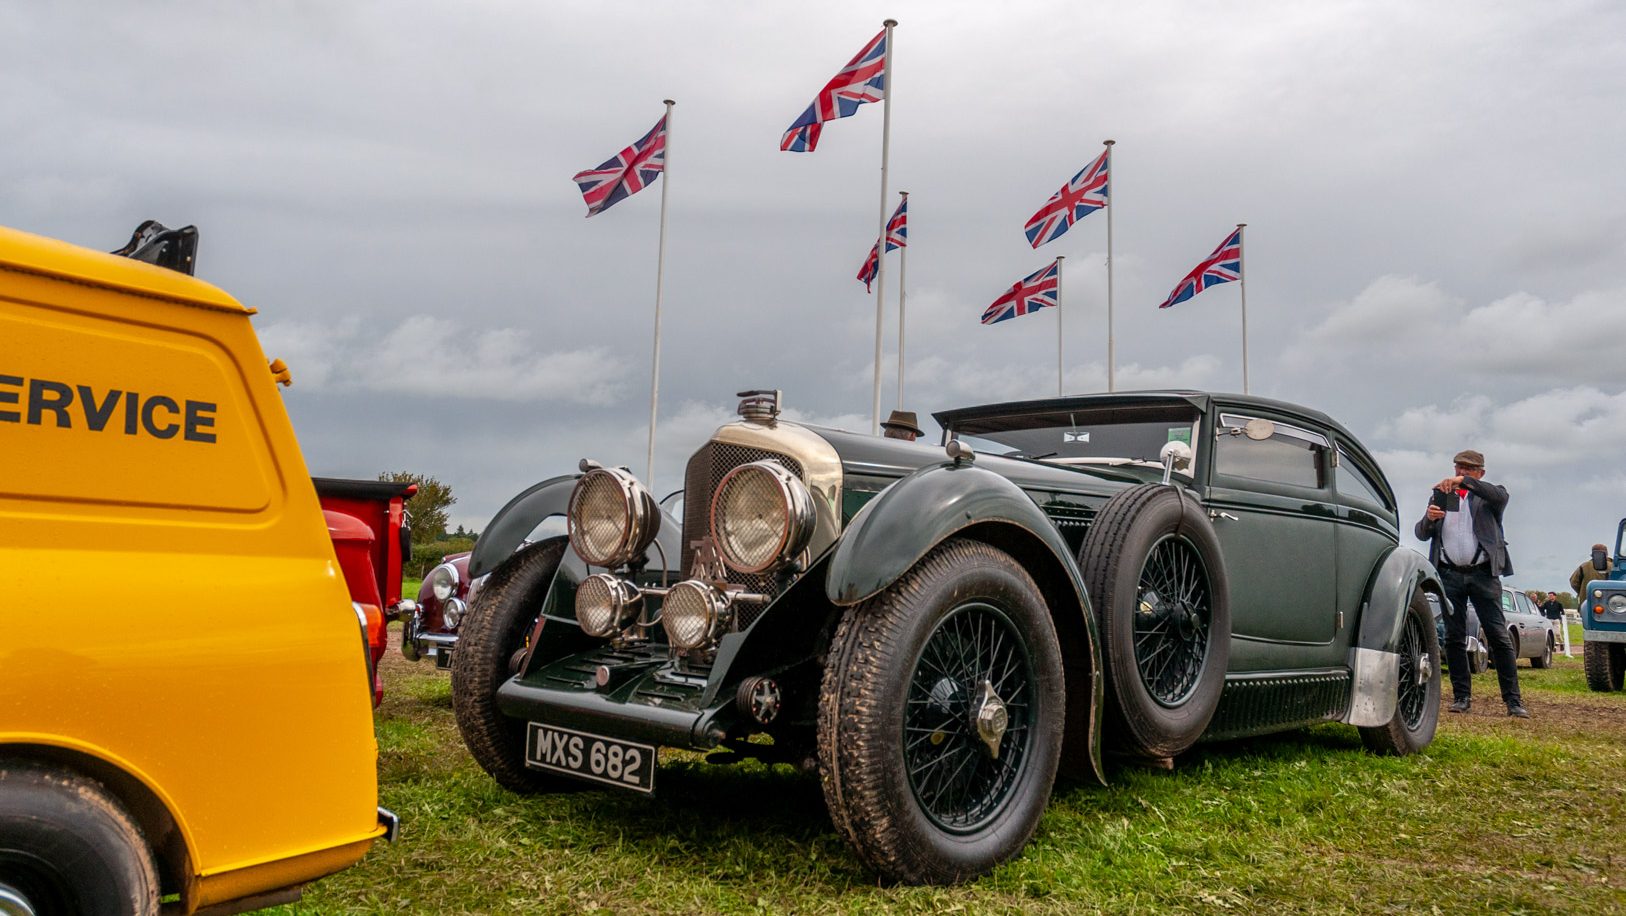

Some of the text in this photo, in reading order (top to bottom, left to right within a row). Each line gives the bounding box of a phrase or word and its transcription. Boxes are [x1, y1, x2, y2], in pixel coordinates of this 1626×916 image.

[0, 374, 217, 444] ERVICE
[536, 728, 641, 784] MXS 682
